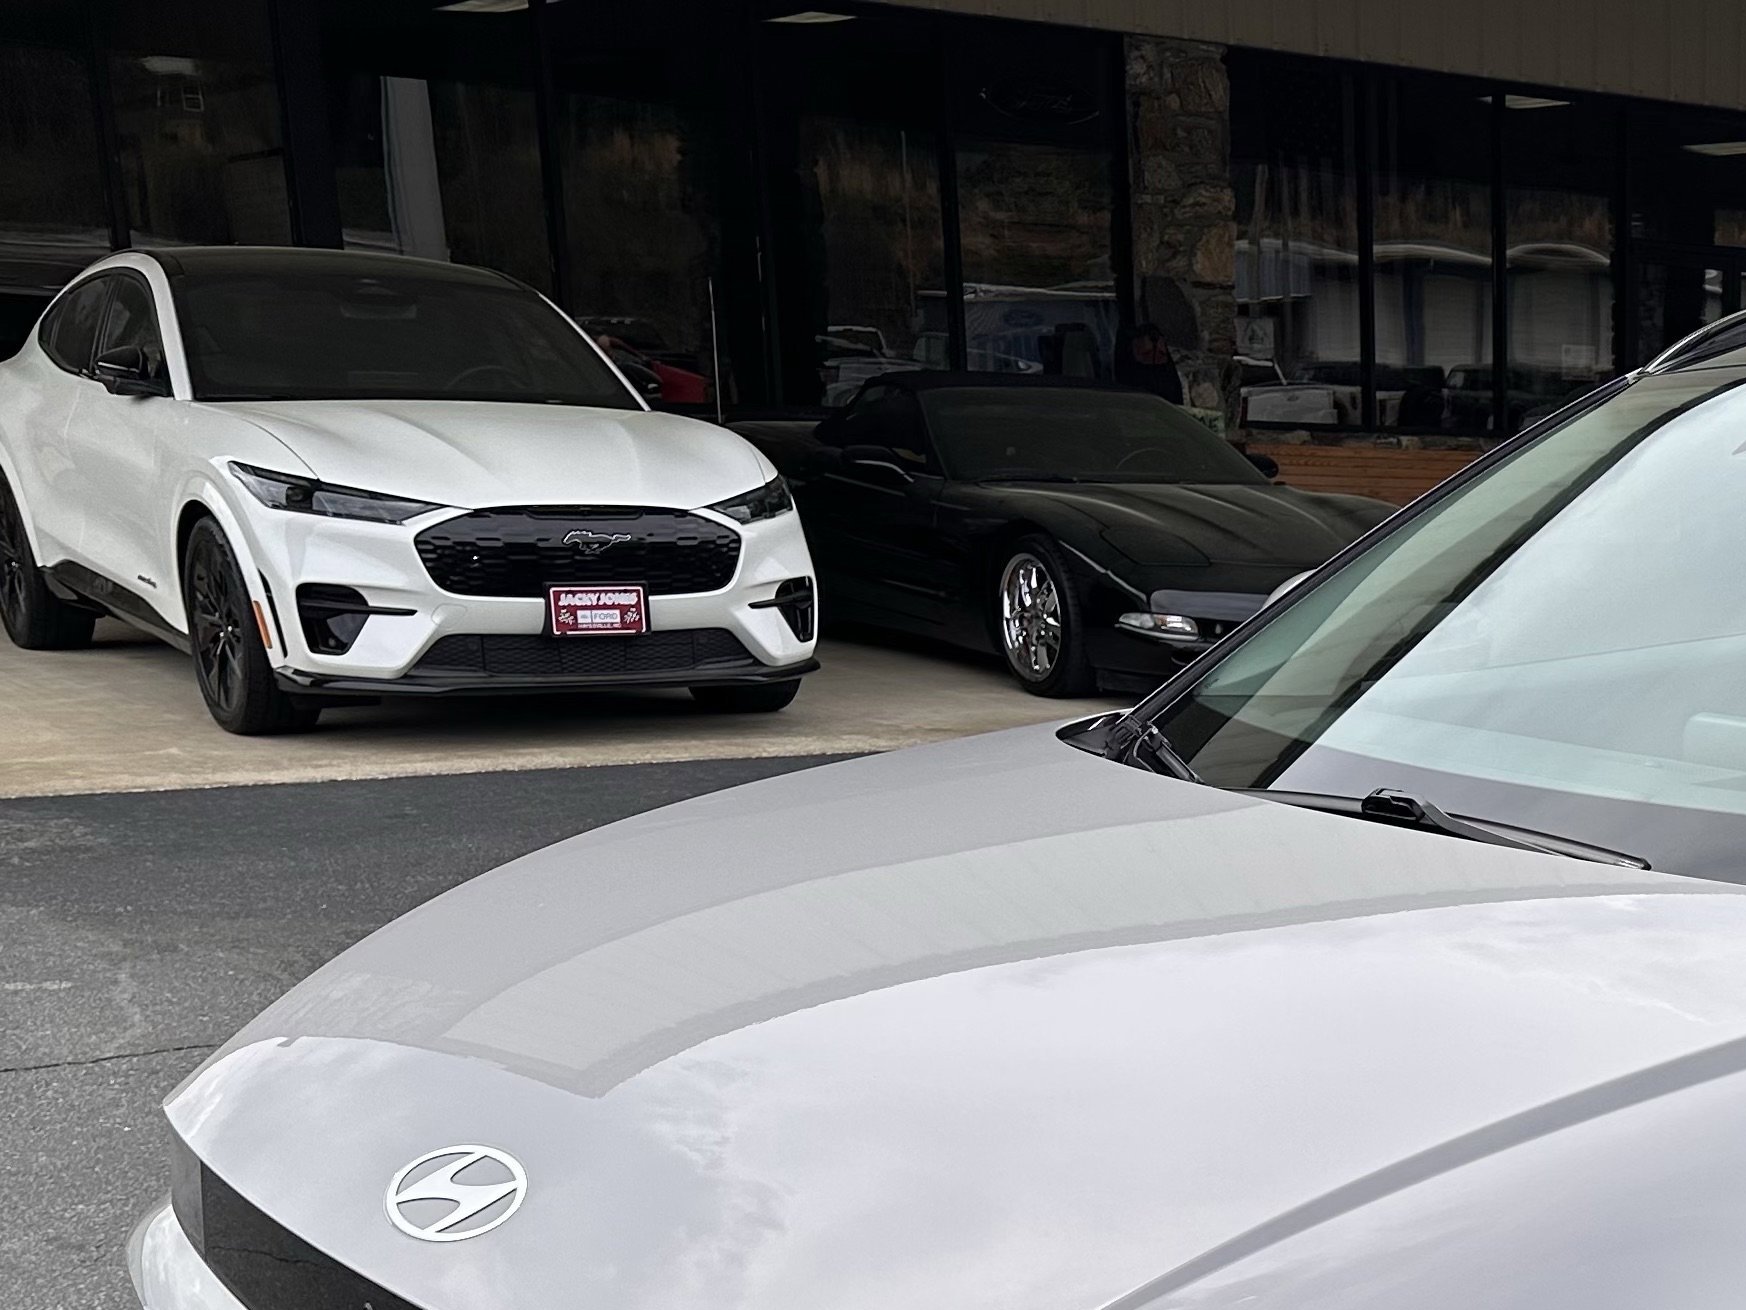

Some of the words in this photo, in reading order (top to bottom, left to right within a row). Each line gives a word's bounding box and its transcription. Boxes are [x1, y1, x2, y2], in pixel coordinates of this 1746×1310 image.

[559, 593, 598, 606] JACKY
[599, 592, 638, 605] JONES
[593, 612, 618, 620] FORD
